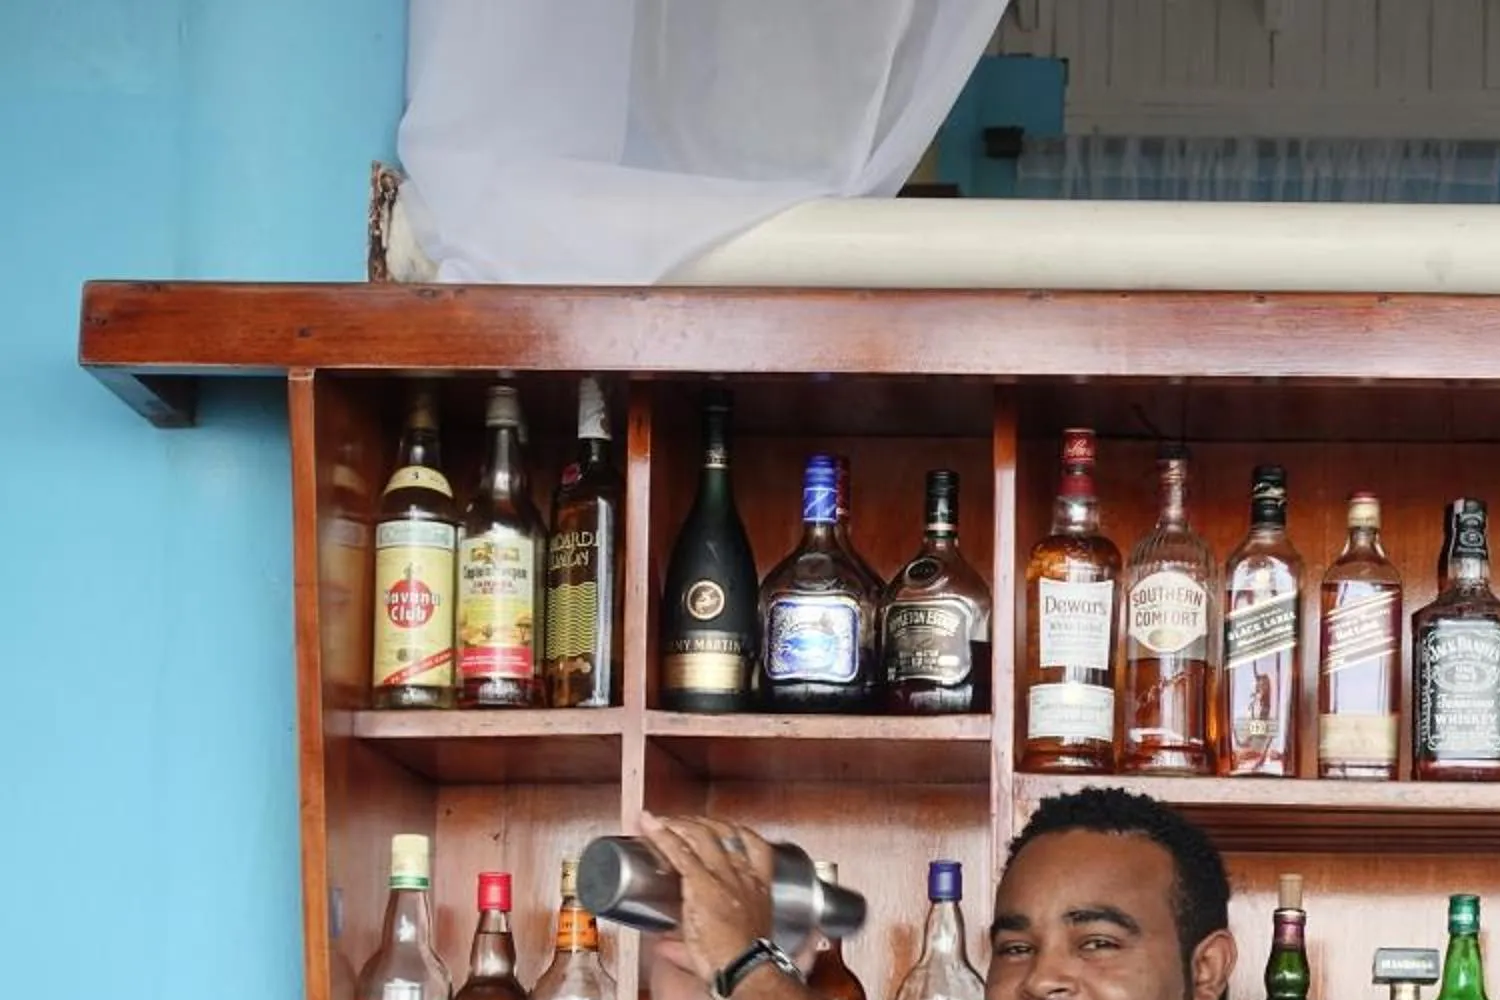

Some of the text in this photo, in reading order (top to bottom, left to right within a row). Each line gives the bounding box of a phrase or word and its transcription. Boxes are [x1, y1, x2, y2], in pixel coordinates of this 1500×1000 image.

[1132, 583, 1202, 607] SOUTHERN
[391, 605, 428, 622] Club
[1135, 611, 1198, 627] COMFORT
